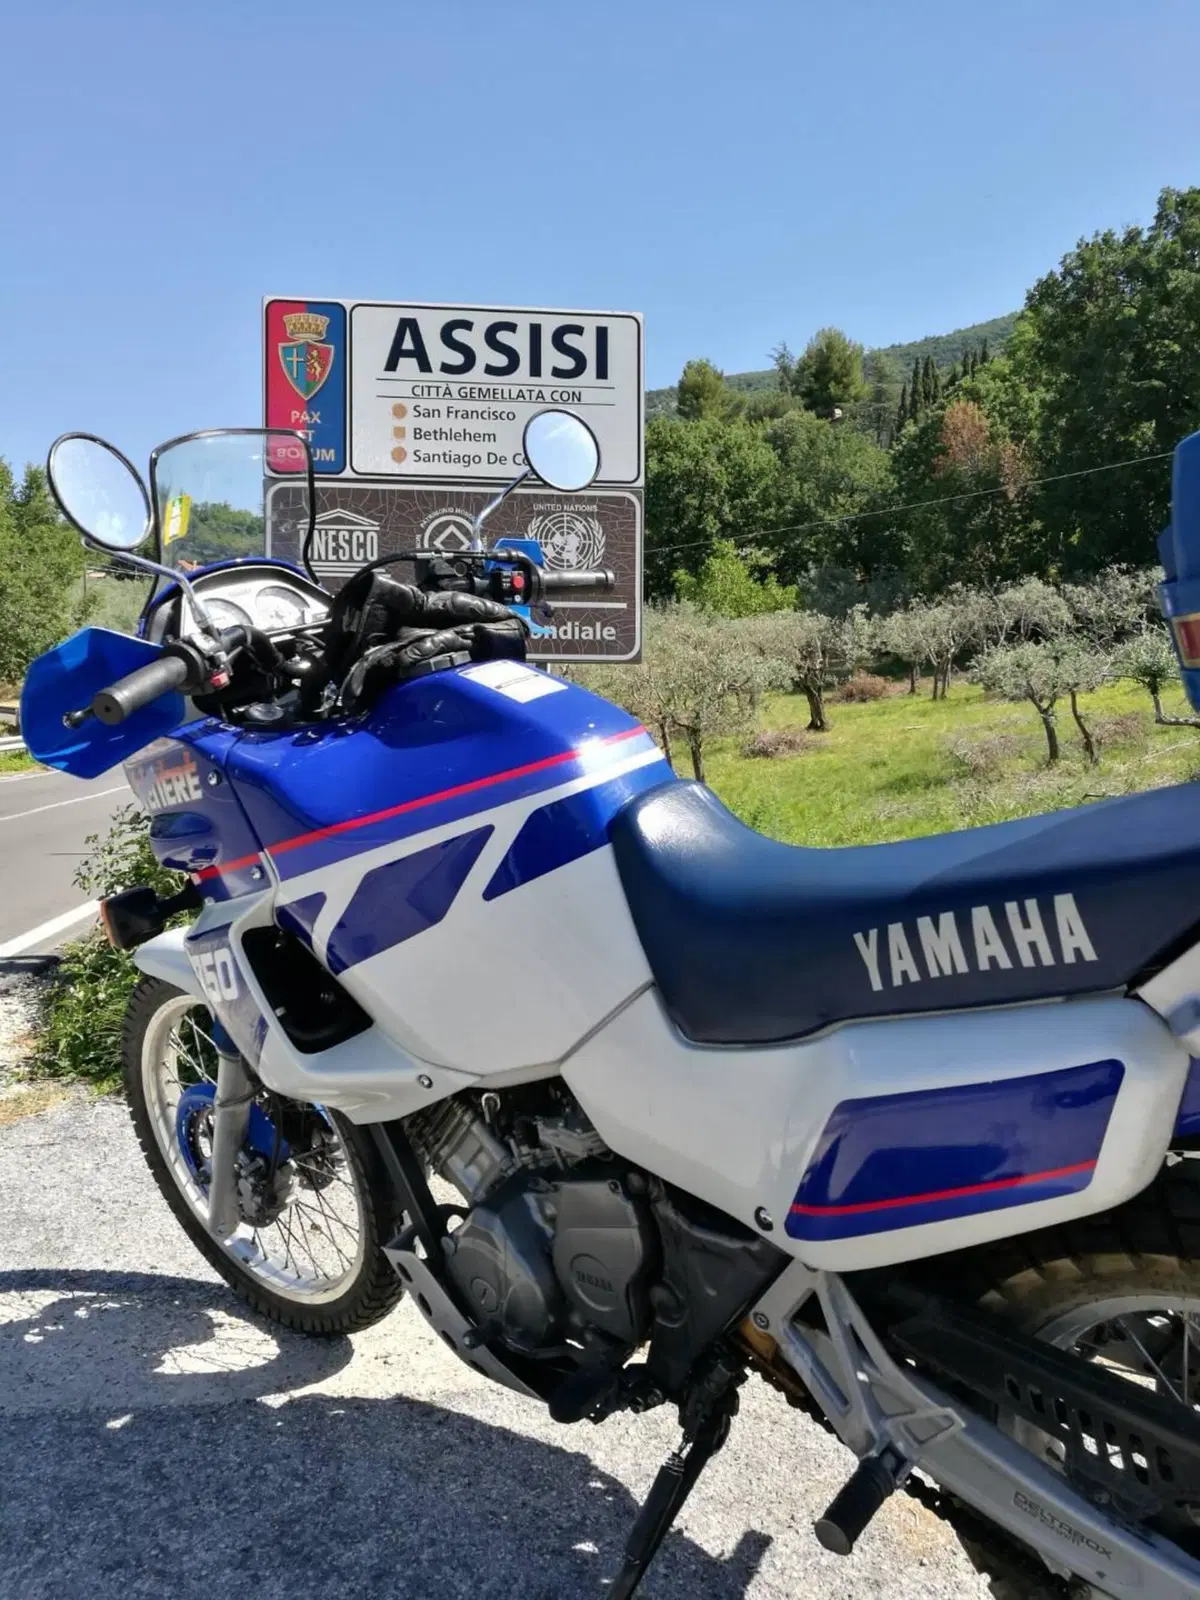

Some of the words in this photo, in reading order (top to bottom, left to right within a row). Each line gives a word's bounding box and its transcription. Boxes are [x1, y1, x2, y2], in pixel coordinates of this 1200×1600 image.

[383, 317, 609, 380] ASSISI
[411, 384, 452, 398] CITTÀ
[457, 386, 546, 402] GEMELLATA
[550, 390, 582, 403] CON
[291, 410, 321, 424] PAX
[413, 404, 441, 419] San
[446, 406, 516, 421] Francisco
[413, 427, 497, 443] Bethlehem
[413, 449, 482, 468] Santiago
[487, 452, 508, 466] De
[533, 503, 562, 512] UNITED
[563, 504, 598, 512] NATIONS
[853, 893, 1098, 992] YAMAHA
